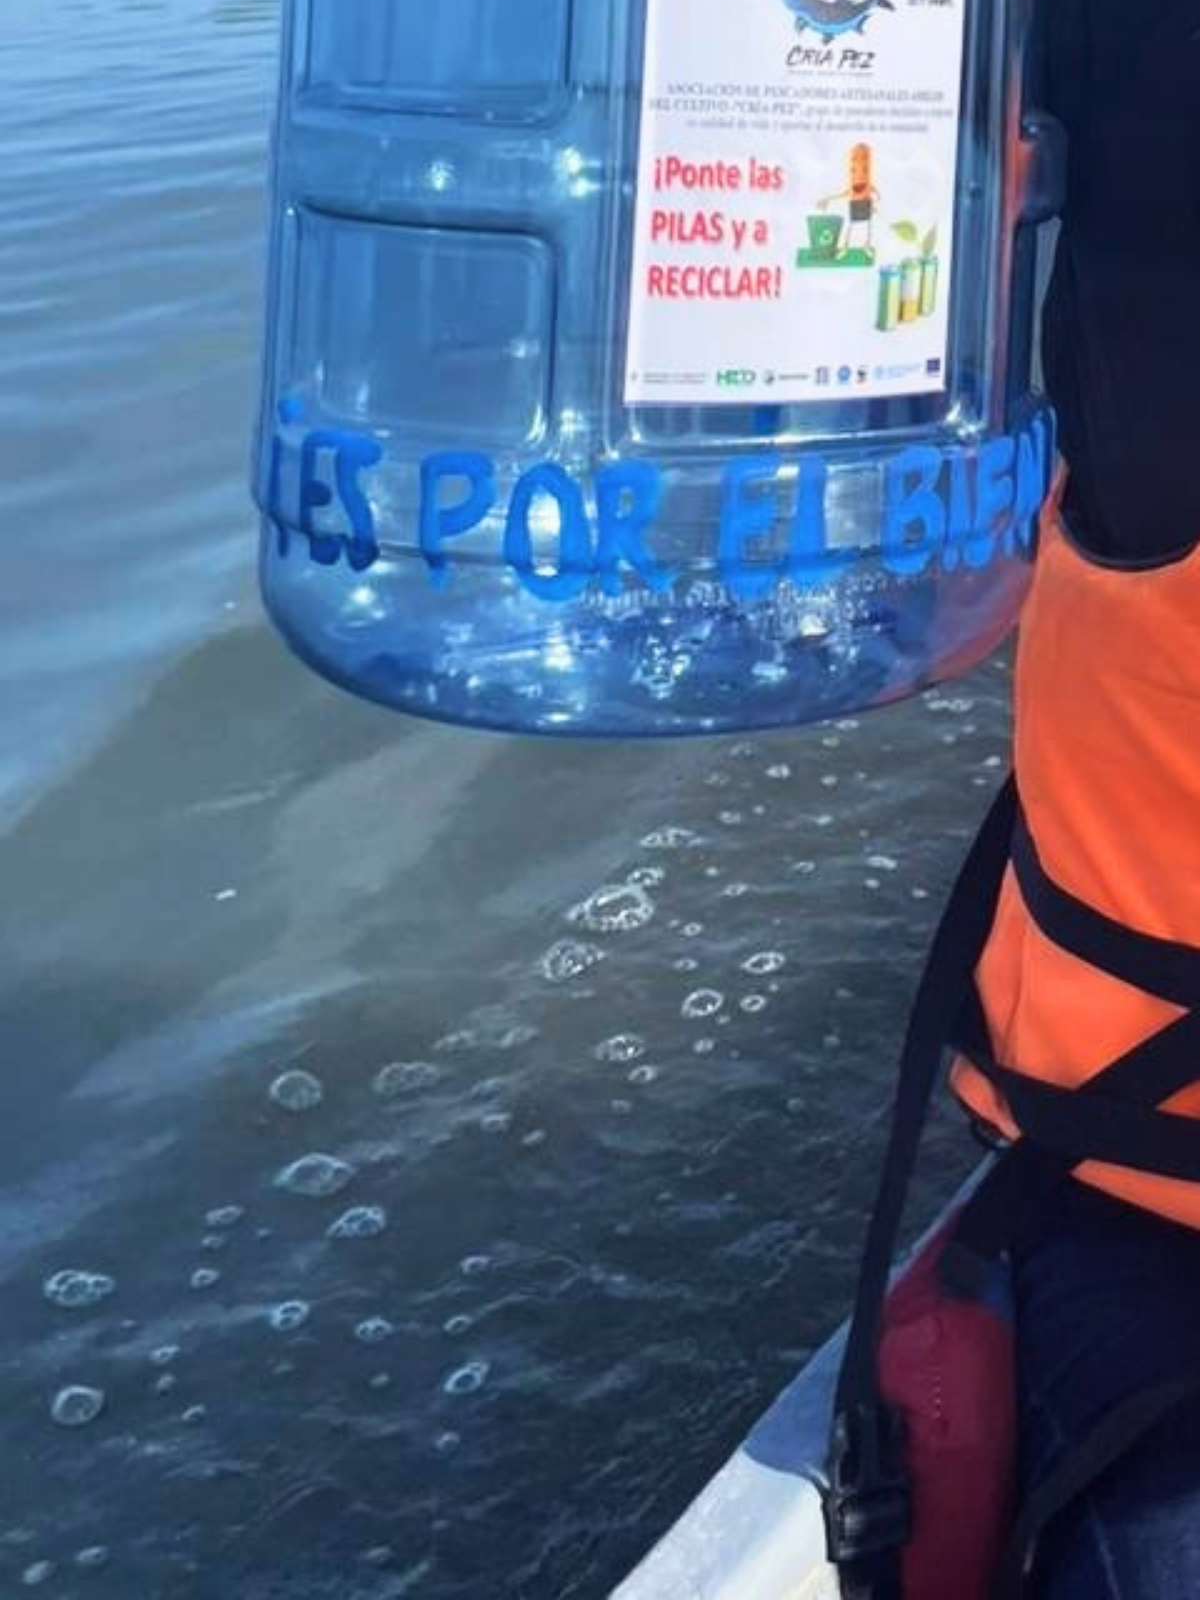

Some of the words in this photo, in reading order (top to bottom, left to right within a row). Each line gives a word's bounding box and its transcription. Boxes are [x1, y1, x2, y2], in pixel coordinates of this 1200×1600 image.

[655, 156, 741, 191] ¡Ponte
[749, 156, 782, 190] las
[651, 210, 724, 242] PILAS
[731, 219, 747, 250] y
[753, 219, 769, 244] a
[647, 265, 782, 300] RECICLAR!
[420, 452, 674, 600] POR
[716, 455, 855, 592] EL
